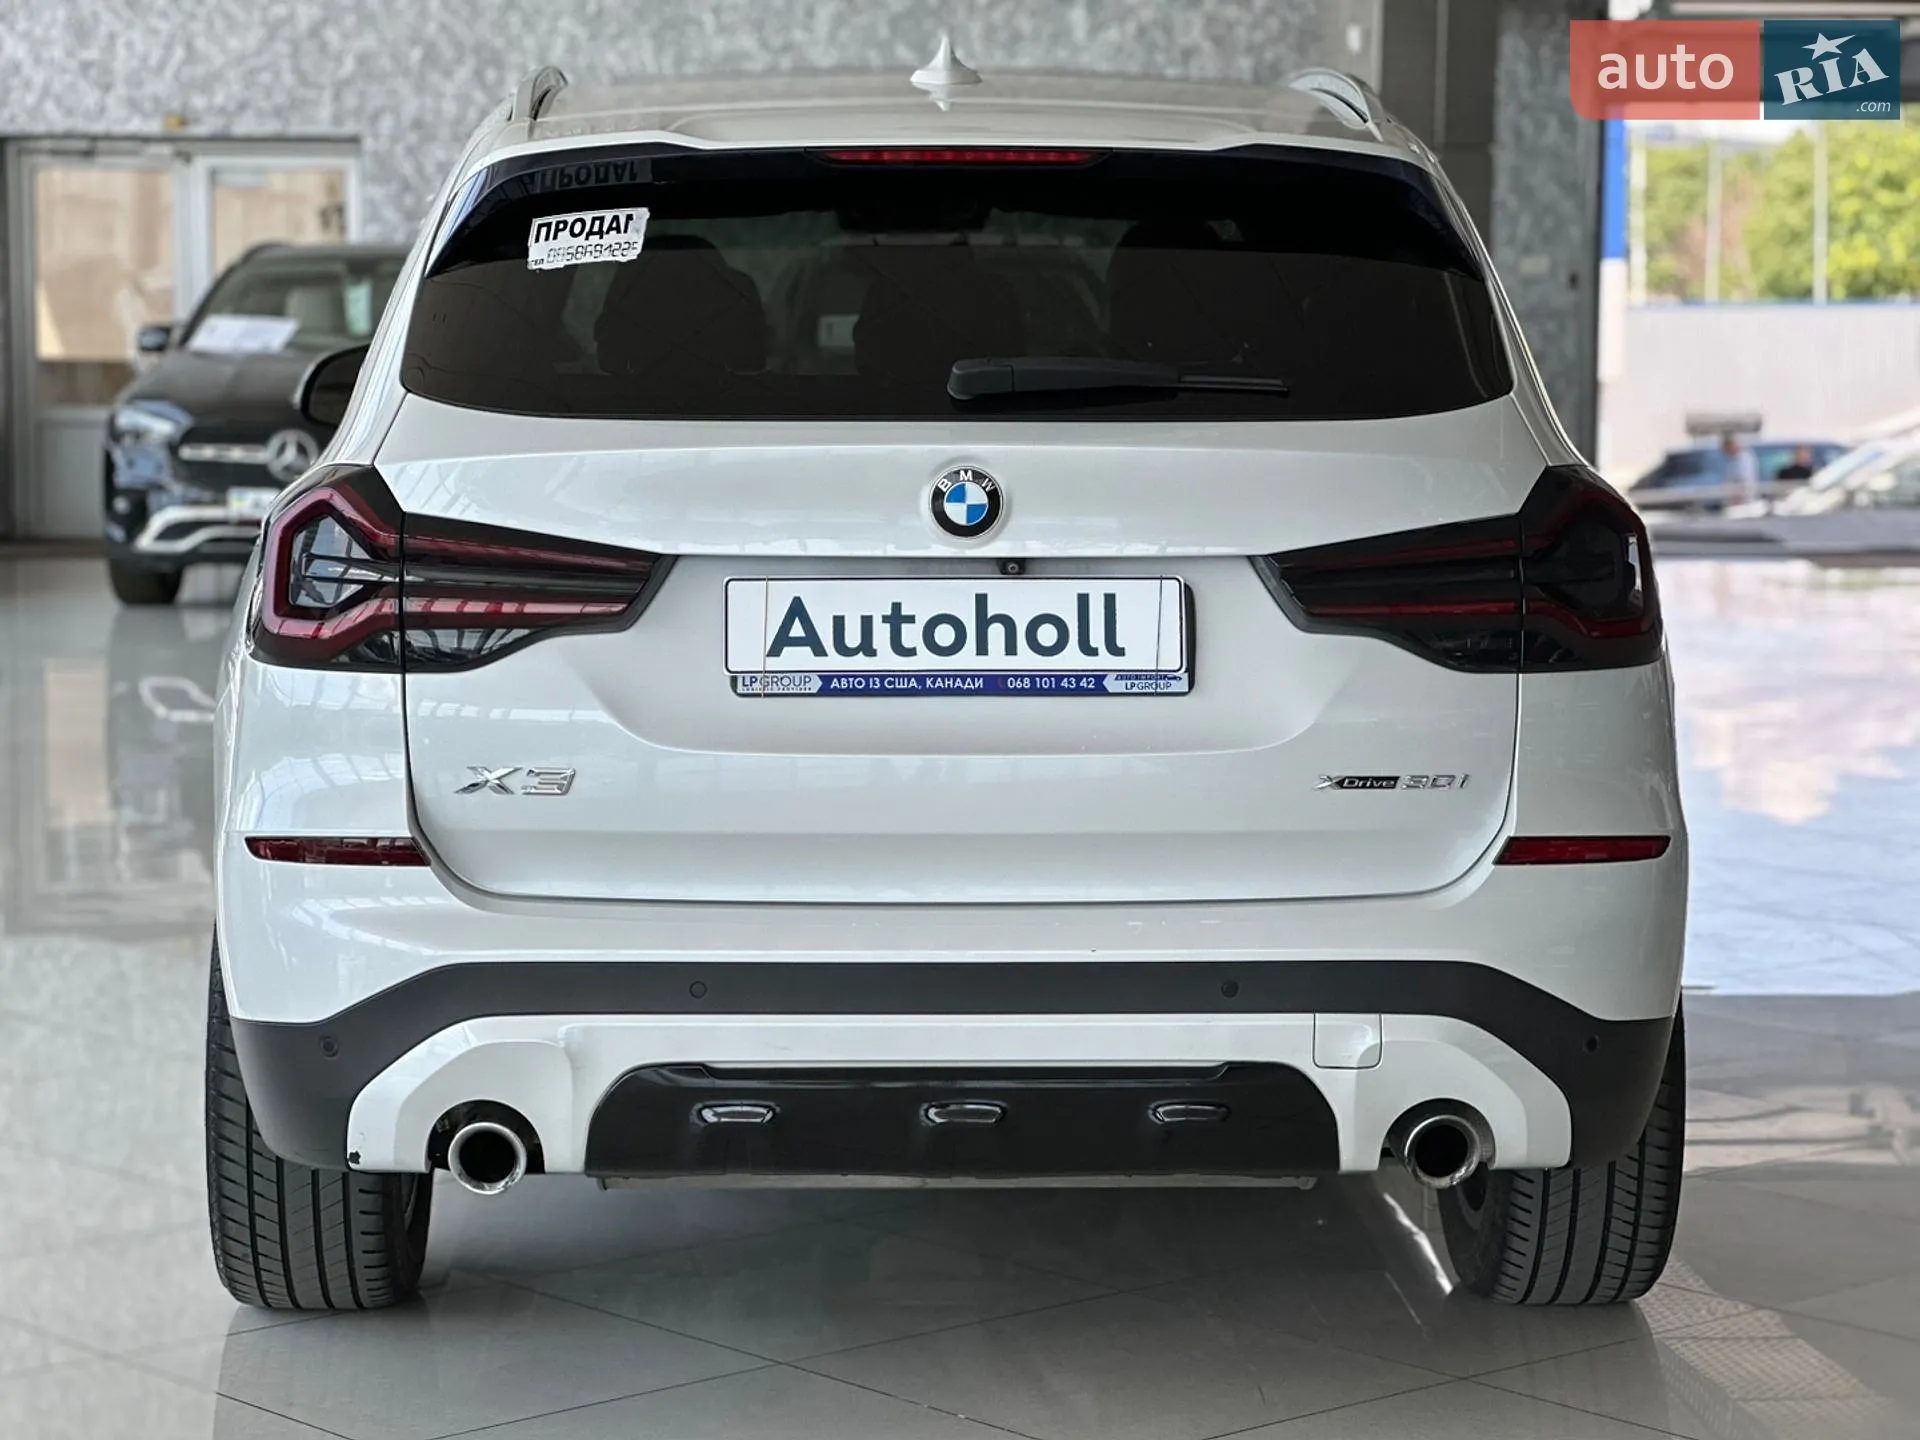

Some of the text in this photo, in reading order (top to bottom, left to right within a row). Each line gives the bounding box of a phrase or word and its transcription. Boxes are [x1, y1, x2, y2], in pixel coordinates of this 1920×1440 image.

[937, 469, 996, 493] BMW
[766, 592, 1126, 658] Autoholl
[830, 677, 866, 689] АВТО
[884, 677, 922, 690] США,
[926, 677, 984, 690] КАНАДИ
[1007, 677, 1095, 688] 068 101 43 42
[453, 766, 576, 796] X3
